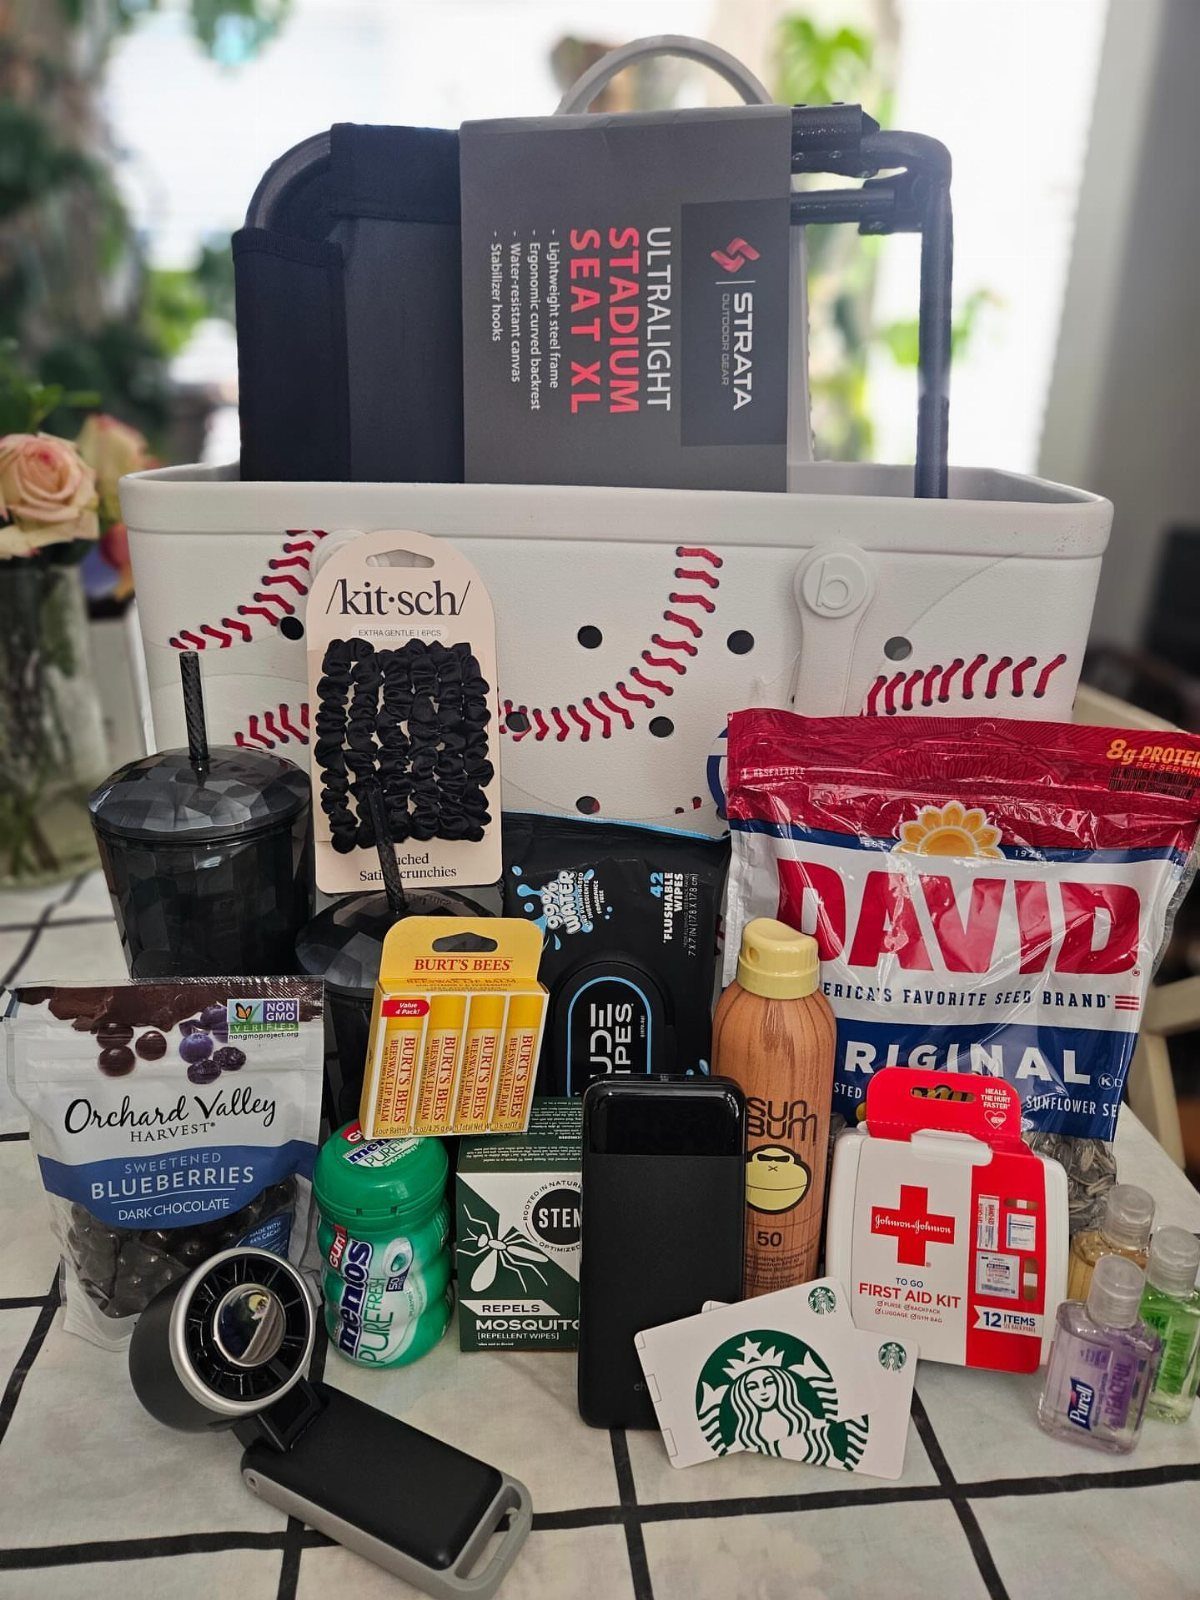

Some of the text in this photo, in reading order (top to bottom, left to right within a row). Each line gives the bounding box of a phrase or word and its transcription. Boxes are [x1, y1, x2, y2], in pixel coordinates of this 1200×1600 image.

[491, 243, 502, 342] Stabilizer hooks
[511, 242, 521, 384] Water-resistant canvas
[527, 242, 541, 411] Ergonomic curved backrest
[547, 241, 561, 389] Lightweight steel frame
[570, 228, 601, 415] SEAT XL
[609, 226, 641, 414] STADIUM
[646, 226, 672, 411] ULTRALIGHT
[721, 292, 730, 387] OUTDOOR GEAR
[733, 291, 753, 411] STRATA
[358, 629, 442, 637] EXTRA GENTLE 6PCS
[1106, 739, 1200, 769] 8g PROTEI
[1136, 761, 1156, 770] PER
[396, 852, 429, 866] uched
[359, 866, 457, 882] Sati crunchies
[650, 871, 664, 899] 42
[541, 880, 564, 930] 99%
[558, 870, 583, 935] WATER
[674, 872, 684, 913] WIPES
[777, 857, 1141, 976] DAVID
[413, 958, 511, 971] BURT'S BEES
[266, 1002, 296, 1012] NON
[823, 982, 1108, 1009] ERICA'S FAVORITE SEED BRAND
[266, 1012, 296, 1022] GMO
[401, 1008, 420, 1016] Pack!
[228, 1032, 300, 1041] nongmoproject.org
[231, 1022, 297, 1032] VERIFIED
[614, 1003, 633, 1074] IPES
[589, 1003, 613, 1079] UDE
[386, 1039, 399, 1079] BEESWAX
[427, 1038, 440, 1078] BEESWAX
[466, 1038, 480, 1077] BEESWAX
[504, 1037, 518, 1077] BEESWAX
[844, 1040, 1091, 1085] RIGINAL
[384, 1081, 393, 1097] LIP
[393, 1036, 416, 1124] BURT'S BEES
[425, 1079, 433, 1095] LIP
[433, 1036, 456, 1122] BURT'S BEES
[465, 1078, 474, 1094] LIP
[472, 1035, 496, 1121] BURT'S BEES
[503, 1077, 513, 1093] LIP
[510, 1035, 534, 1120] BURT'S BEES
[985, 1087, 1007, 1095] HEALS
[64, 1086, 277, 1135] Orchard Valley
[380, 1098, 392, 1122] BALM
[421, 1096, 432, 1121] BALM
[459, 1094, 472, 1119] BALM
[498, 1094, 511, 1117] BALM
[834, 1082, 862, 1099] STED
[1026, 1095, 1096, 1115] SUNFLOWER
[981, 1094, 1011, 1103] THE HURT
[983, 1101, 1009, 1109] FASTER
[130, 1122, 209, 1143] HARVEST
[124, 1152, 222, 1175] SWEETENED
[365, 1142, 402, 1167] PURE
[91, 1166, 254, 1200] BLUEBERRIES
[118, 1198, 230, 1221] DARK CHOCOLATE
[523, 1190, 540, 1221] ROOTED
[539, 1184, 548, 1193] IN
[329, 1232, 347, 1269] GUM
[539, 1241, 581, 1253] OPTIMIZED
[757, 1231, 782, 1247] 50
[387, 1277, 398, 1292] 50
[859, 1282, 961, 1309] FIRST AID KIT
[896, 1277, 924, 1288] TO GO
[339, 1240, 374, 1360] mentos
[482, 1304, 541, 1313] REPELS
[881, 1309, 908, 1318] LUGGAGE
[910, 1305, 941, 1314] BACKPACK
[356, 1277, 395, 1364] PURE FRESH
[983, 1311, 1002, 1328] 12
[1003, 1313, 1036, 1327] ITEMS
[477, 1332, 560, 1341] [REPELLENT WIPES]
[1069, 1384, 1093, 1424] Purell
